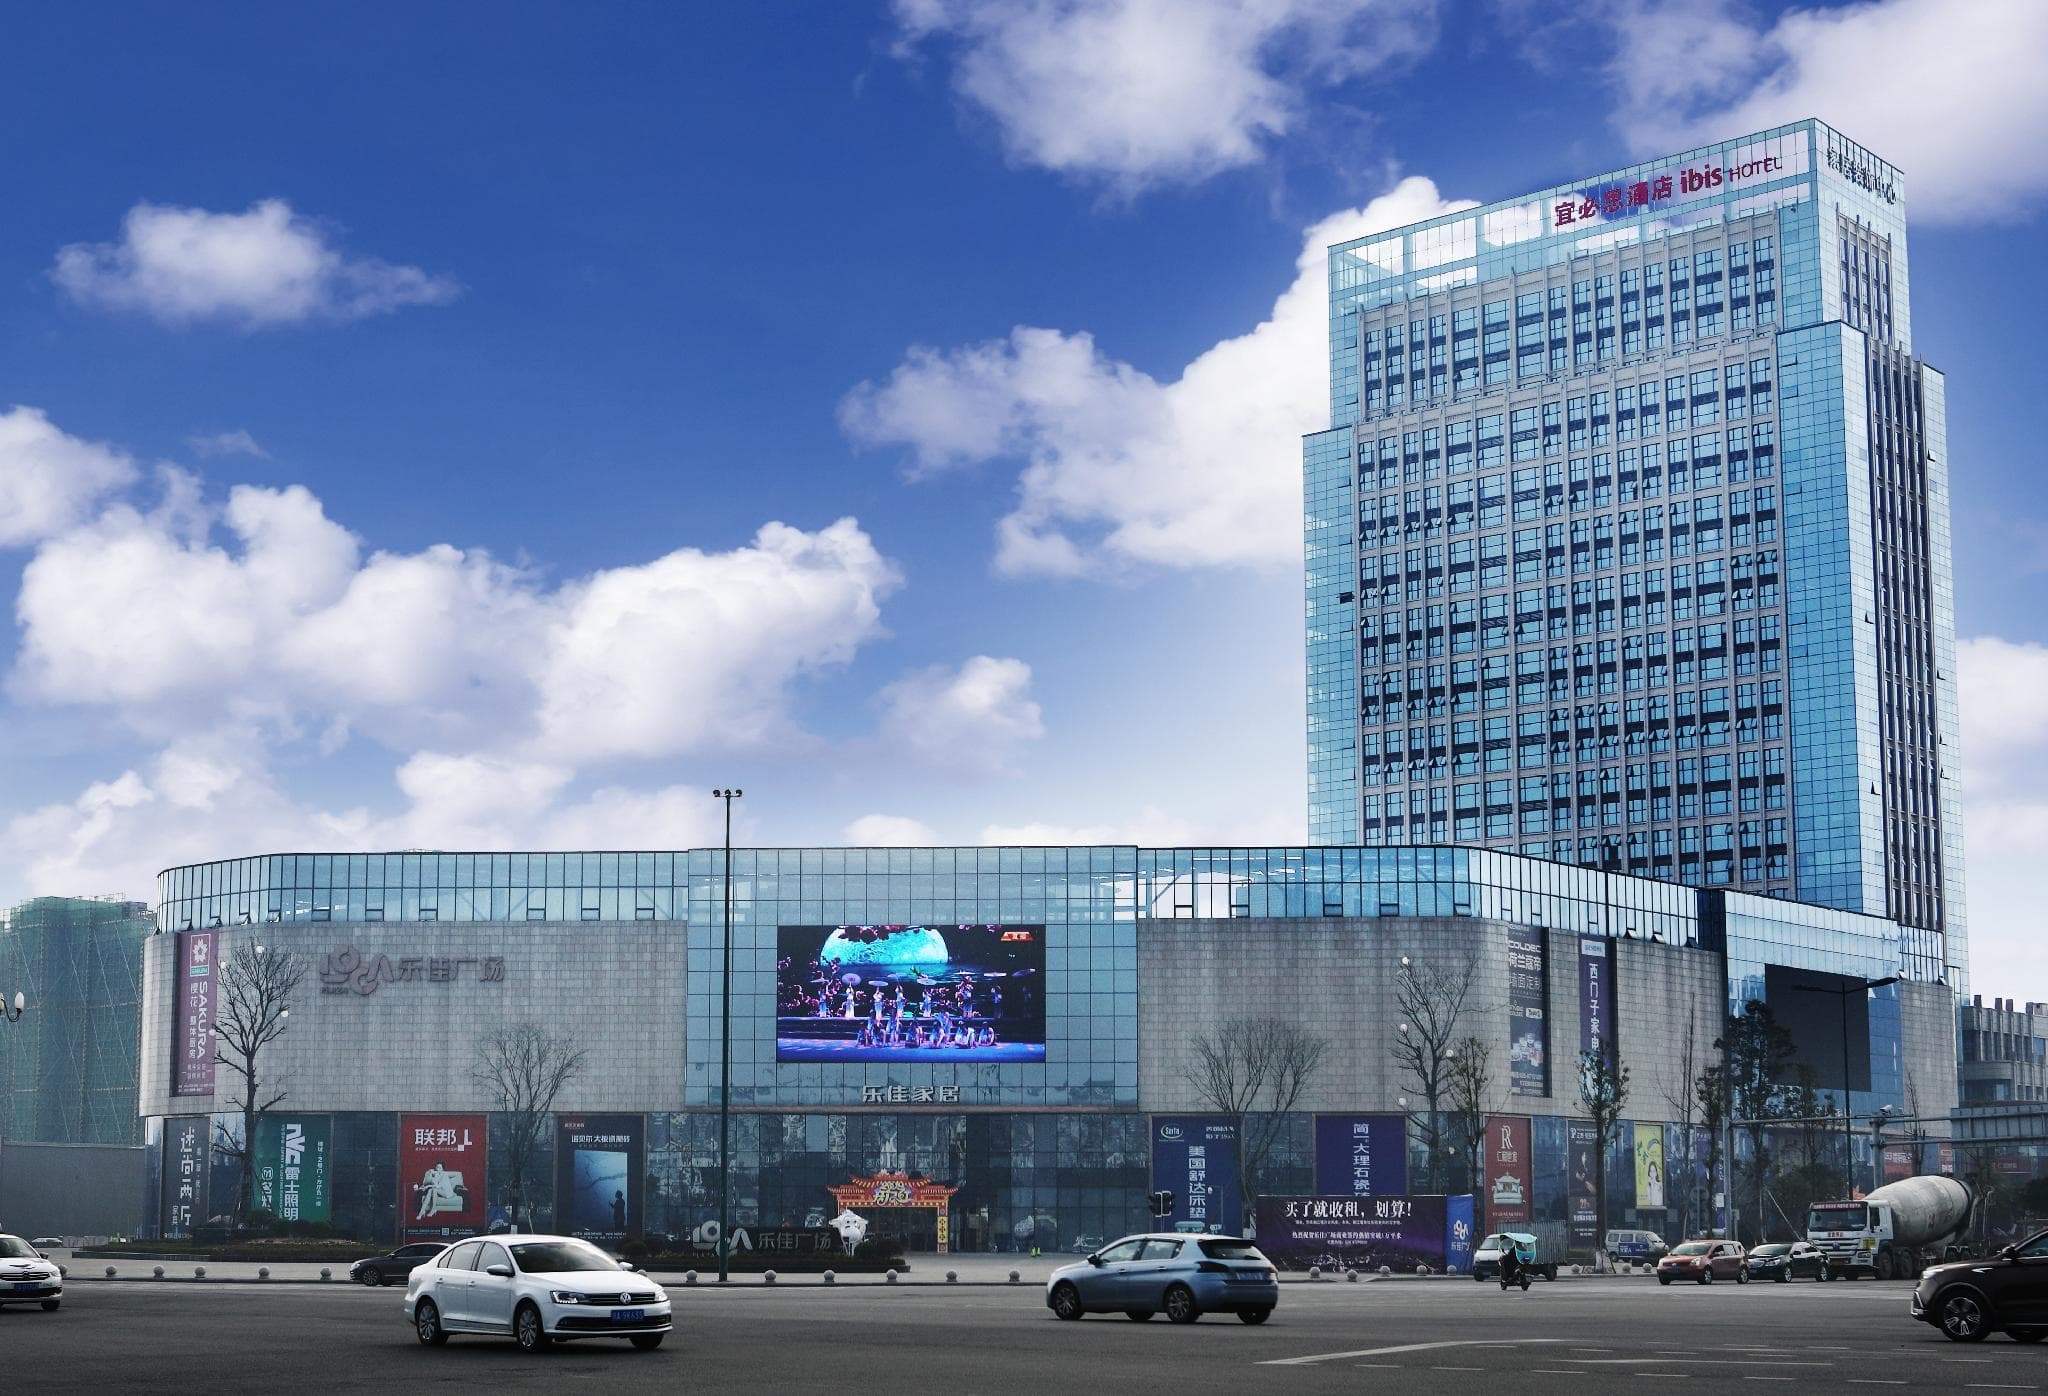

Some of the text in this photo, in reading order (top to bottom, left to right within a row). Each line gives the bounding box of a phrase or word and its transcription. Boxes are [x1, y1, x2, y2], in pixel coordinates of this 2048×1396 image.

[1681, 157, 1783, 194] ibis HOTEL
[1555, 175, 1672, 227] 宜必思酒店
[399, 955, 505, 983] 乐佳广场
[197, 981, 208, 1059] SAKURA
[1588, 963, 1600, 1051] 西门子家电
[862, 1085, 961, 1103] 乐佳家居
[414, 1128, 457, 1145] 联邦
[284, 1167, 300, 1220] 雷士照明
[1188, 1146, 1206, 1219] 美国舒达床垫
[758, 1232, 832, 1250] 乐佳广场
